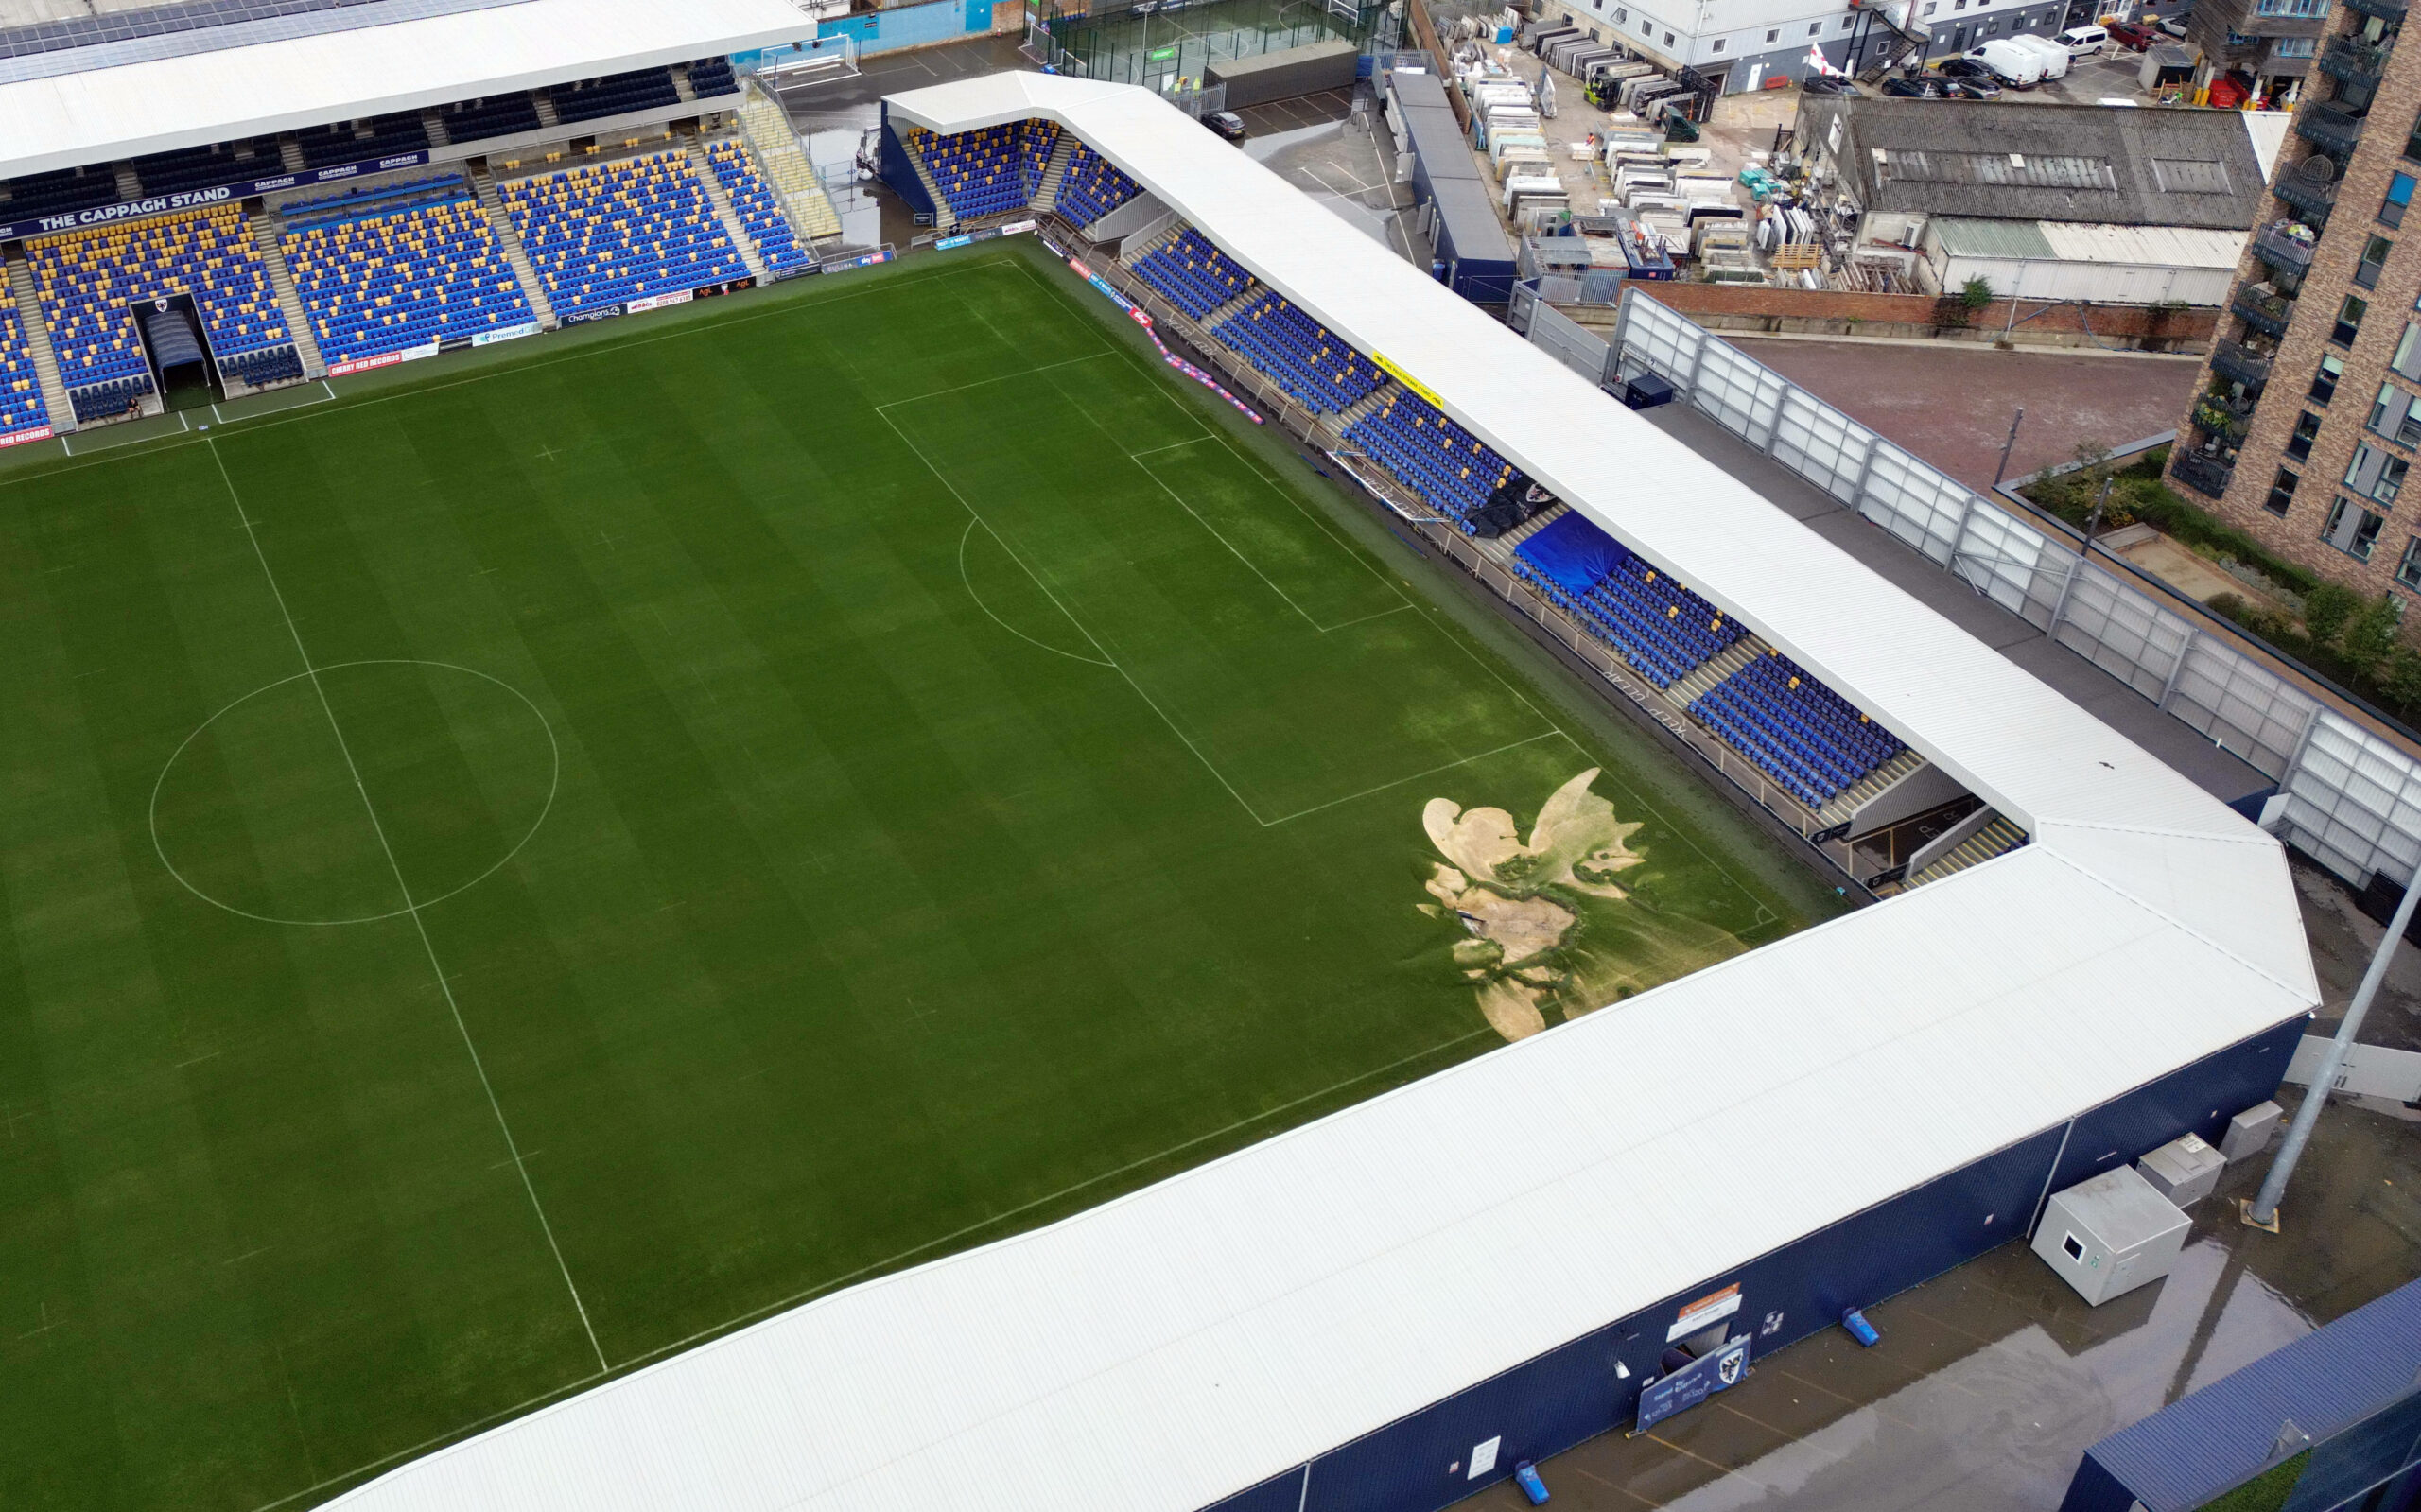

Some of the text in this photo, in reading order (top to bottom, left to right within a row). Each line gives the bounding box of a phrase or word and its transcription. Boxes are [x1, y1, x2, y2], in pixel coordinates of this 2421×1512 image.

[379, 154, 417, 165] CAPPAGH
[318, 165, 357, 177] CAPPAGH
[254, 176, 294, 188] CAPPAGH
[39, 187, 230, 231] THE CAPPAGH STAND
[568, 308, 609, 323] Champions
[331, 353, 400, 375] CHERRY RED RECORDS
[0, 427, 50, 445] RED RECORDS
[1603, 671, 1686, 736] KEEP CLEAR
